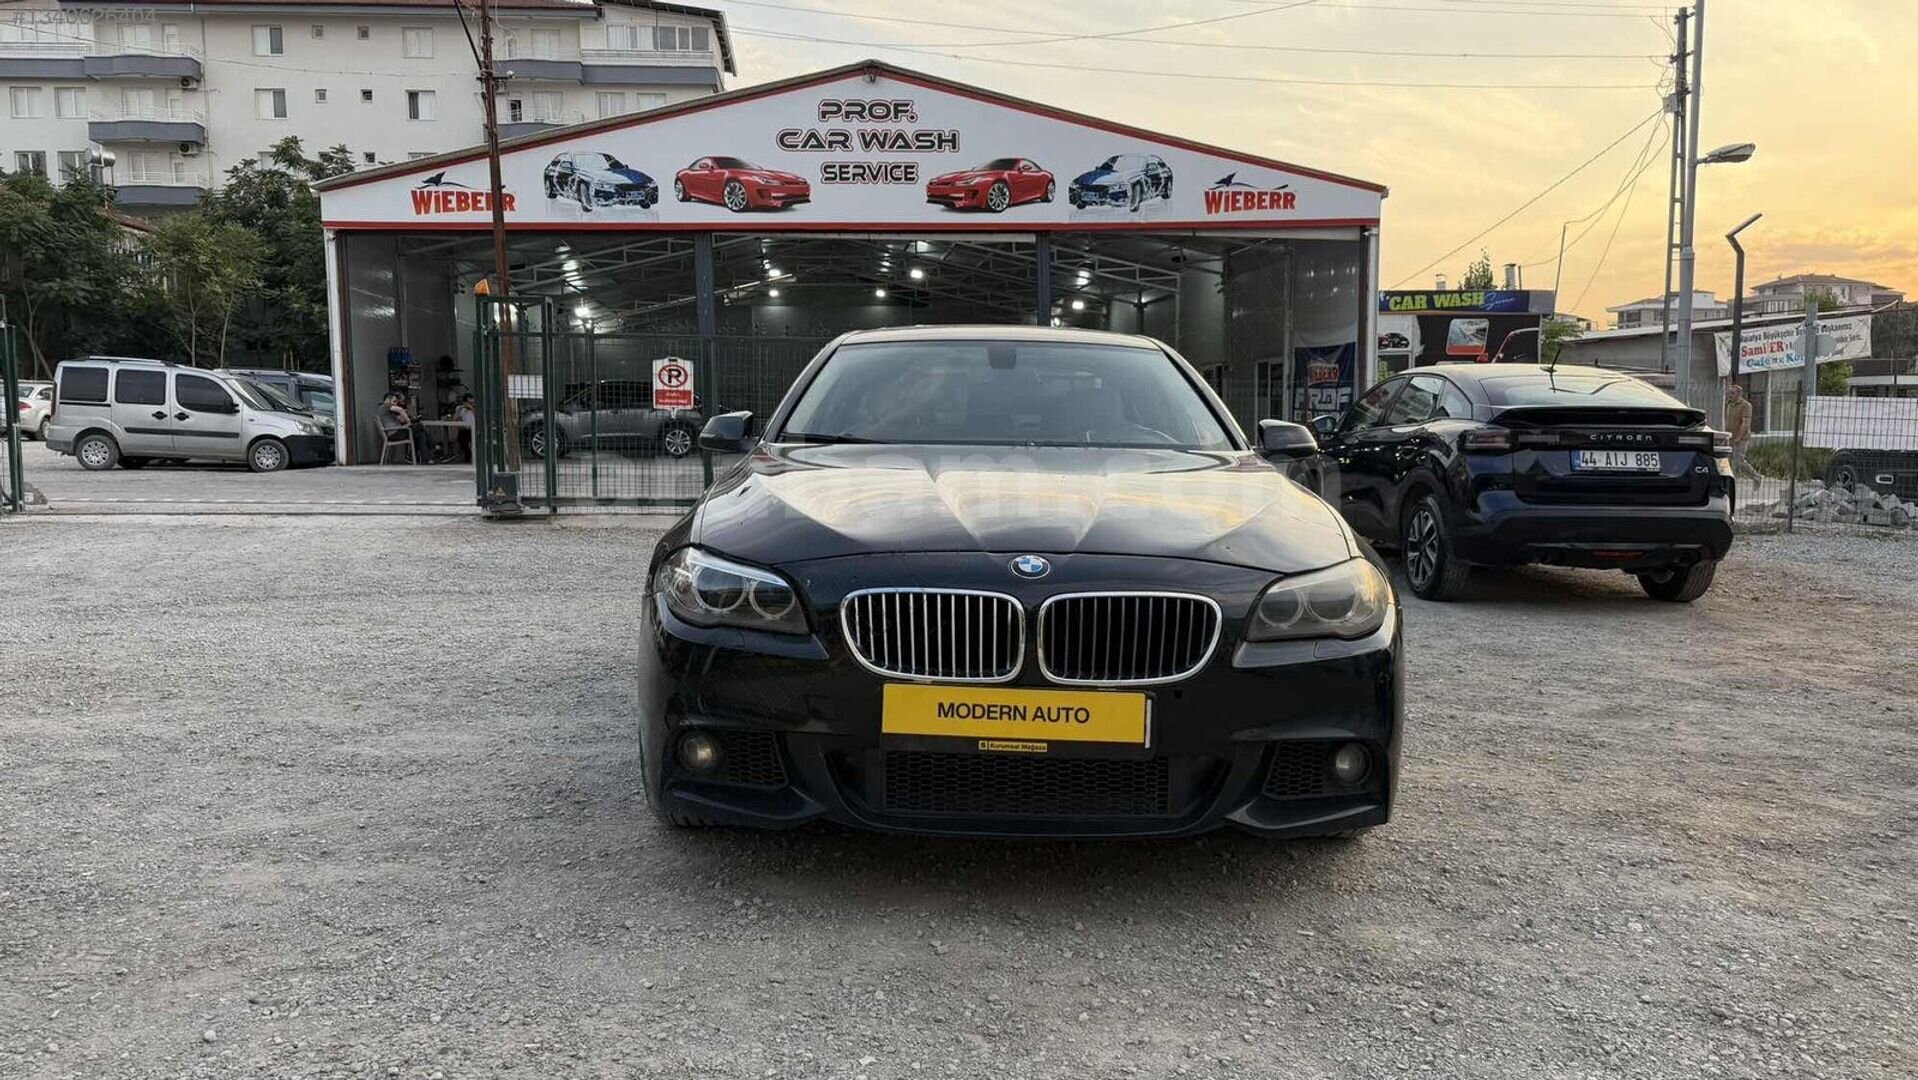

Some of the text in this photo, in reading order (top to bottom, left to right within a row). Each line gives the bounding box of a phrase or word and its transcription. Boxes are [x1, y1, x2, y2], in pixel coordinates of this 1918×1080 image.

[819, 100, 917, 121] PROF.
[777, 129, 959, 152] CAR WASH
[821, 162, 918, 183] SERVICE
[1389, 295, 1427, 311] CAR
[1434, 292, 1485, 308] WASH
[1581, 452, 1658, 467] 44 AIJ 885
[937, 702, 1090, 724] MODERN AUTO
